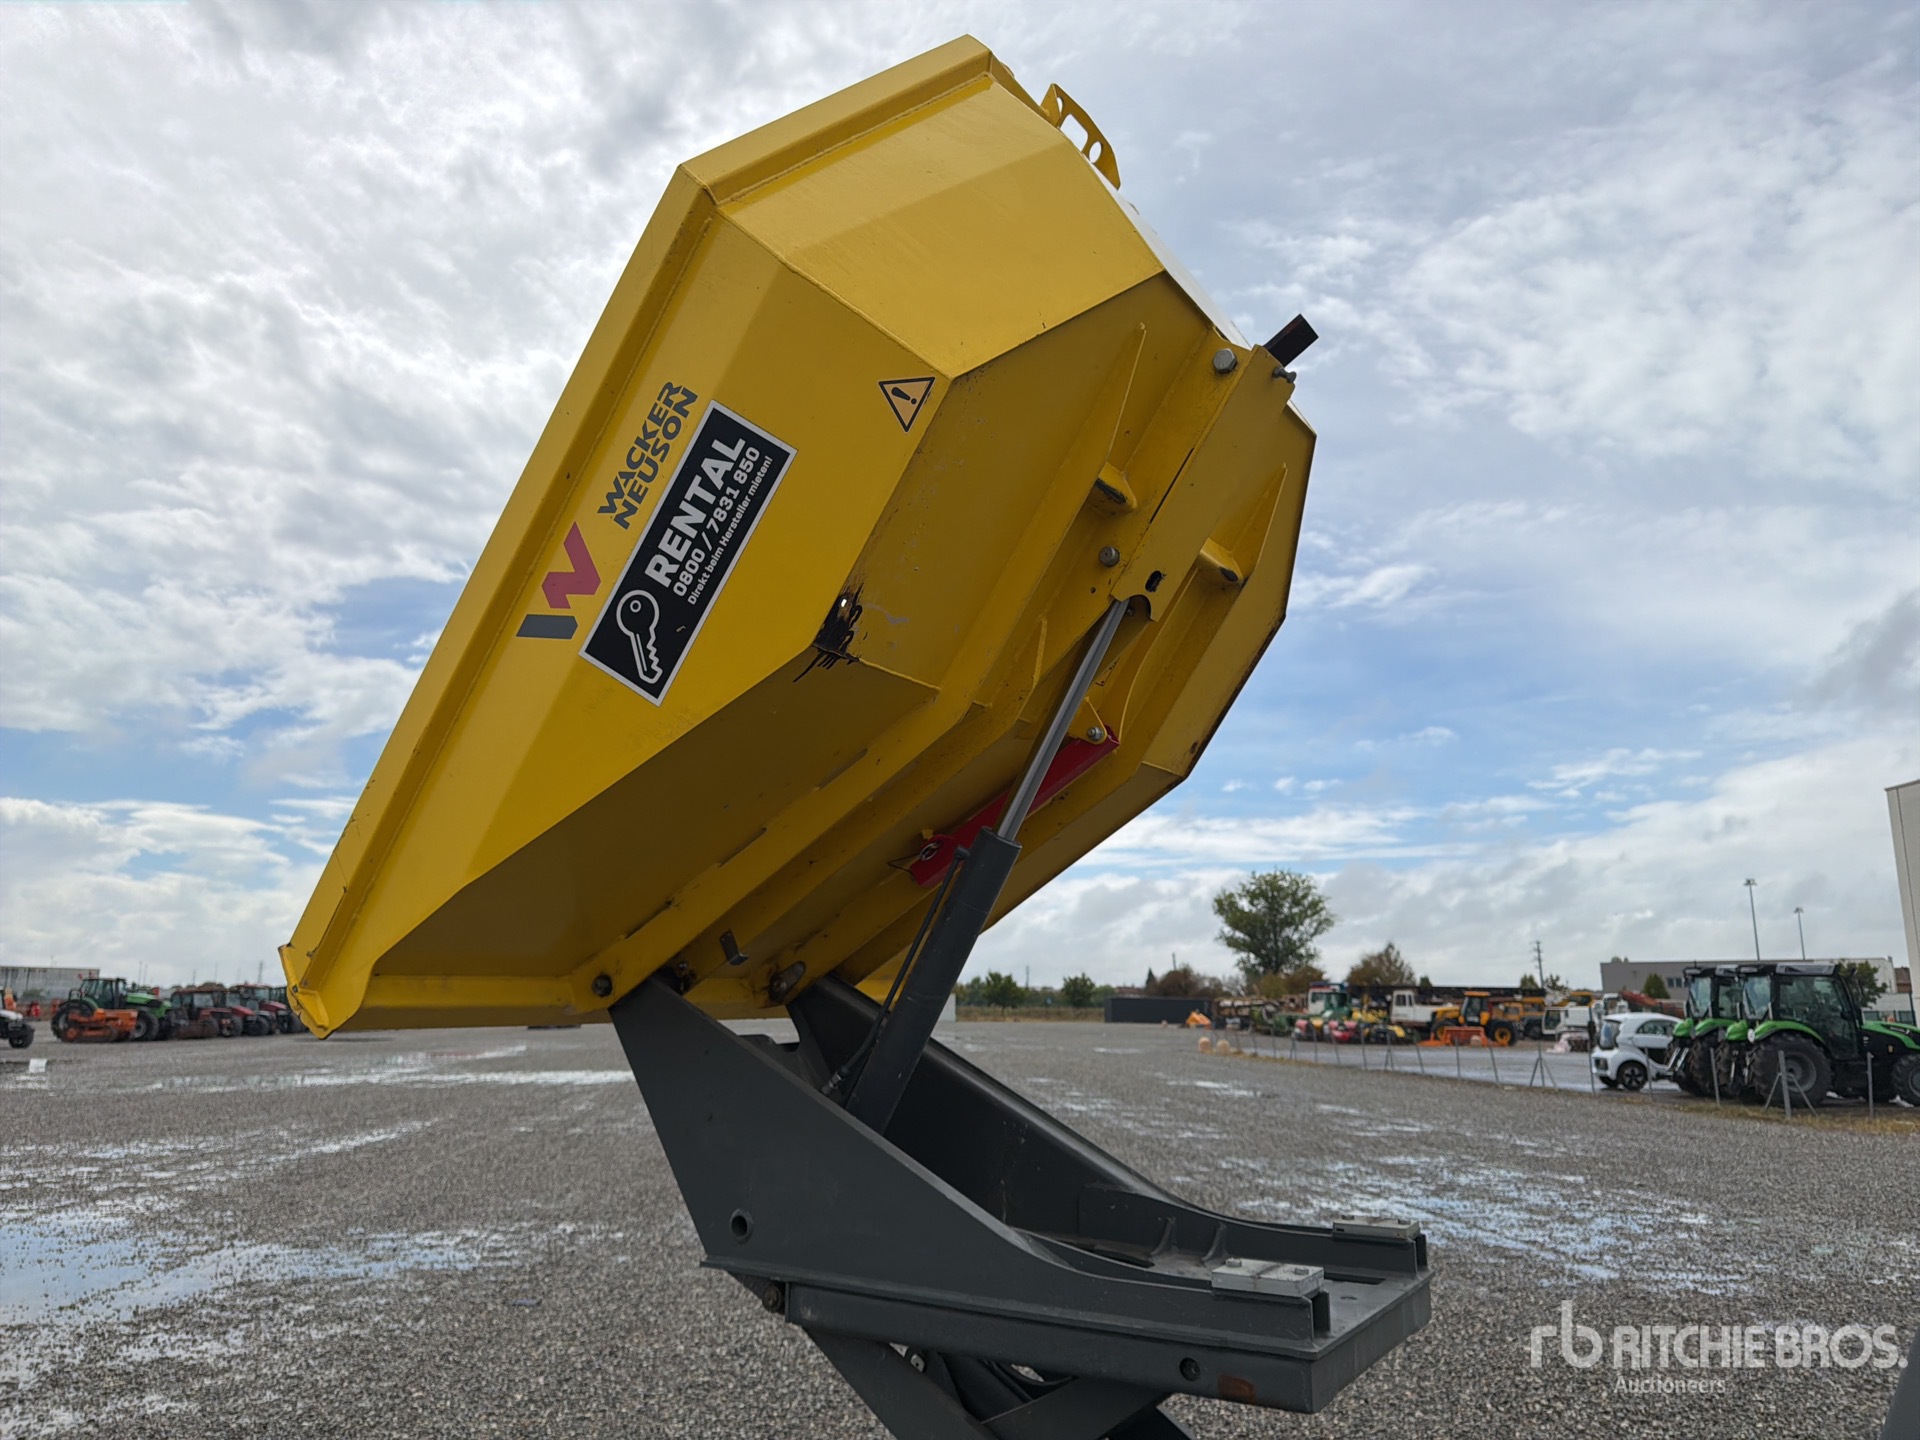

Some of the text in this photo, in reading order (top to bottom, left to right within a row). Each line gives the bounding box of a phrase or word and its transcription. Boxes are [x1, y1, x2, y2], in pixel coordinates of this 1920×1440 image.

[597, 381, 683, 514] WACKER
[613, 385, 698, 530] NEUSON
[645, 438, 746, 588] RENTAL
[673, 547, 706, 597] 0800
[706, 486, 740, 534] 7831
[733, 447, 760, 485] 850
[687, 455, 773, 605] Direkt beim Hersteller mieten!
